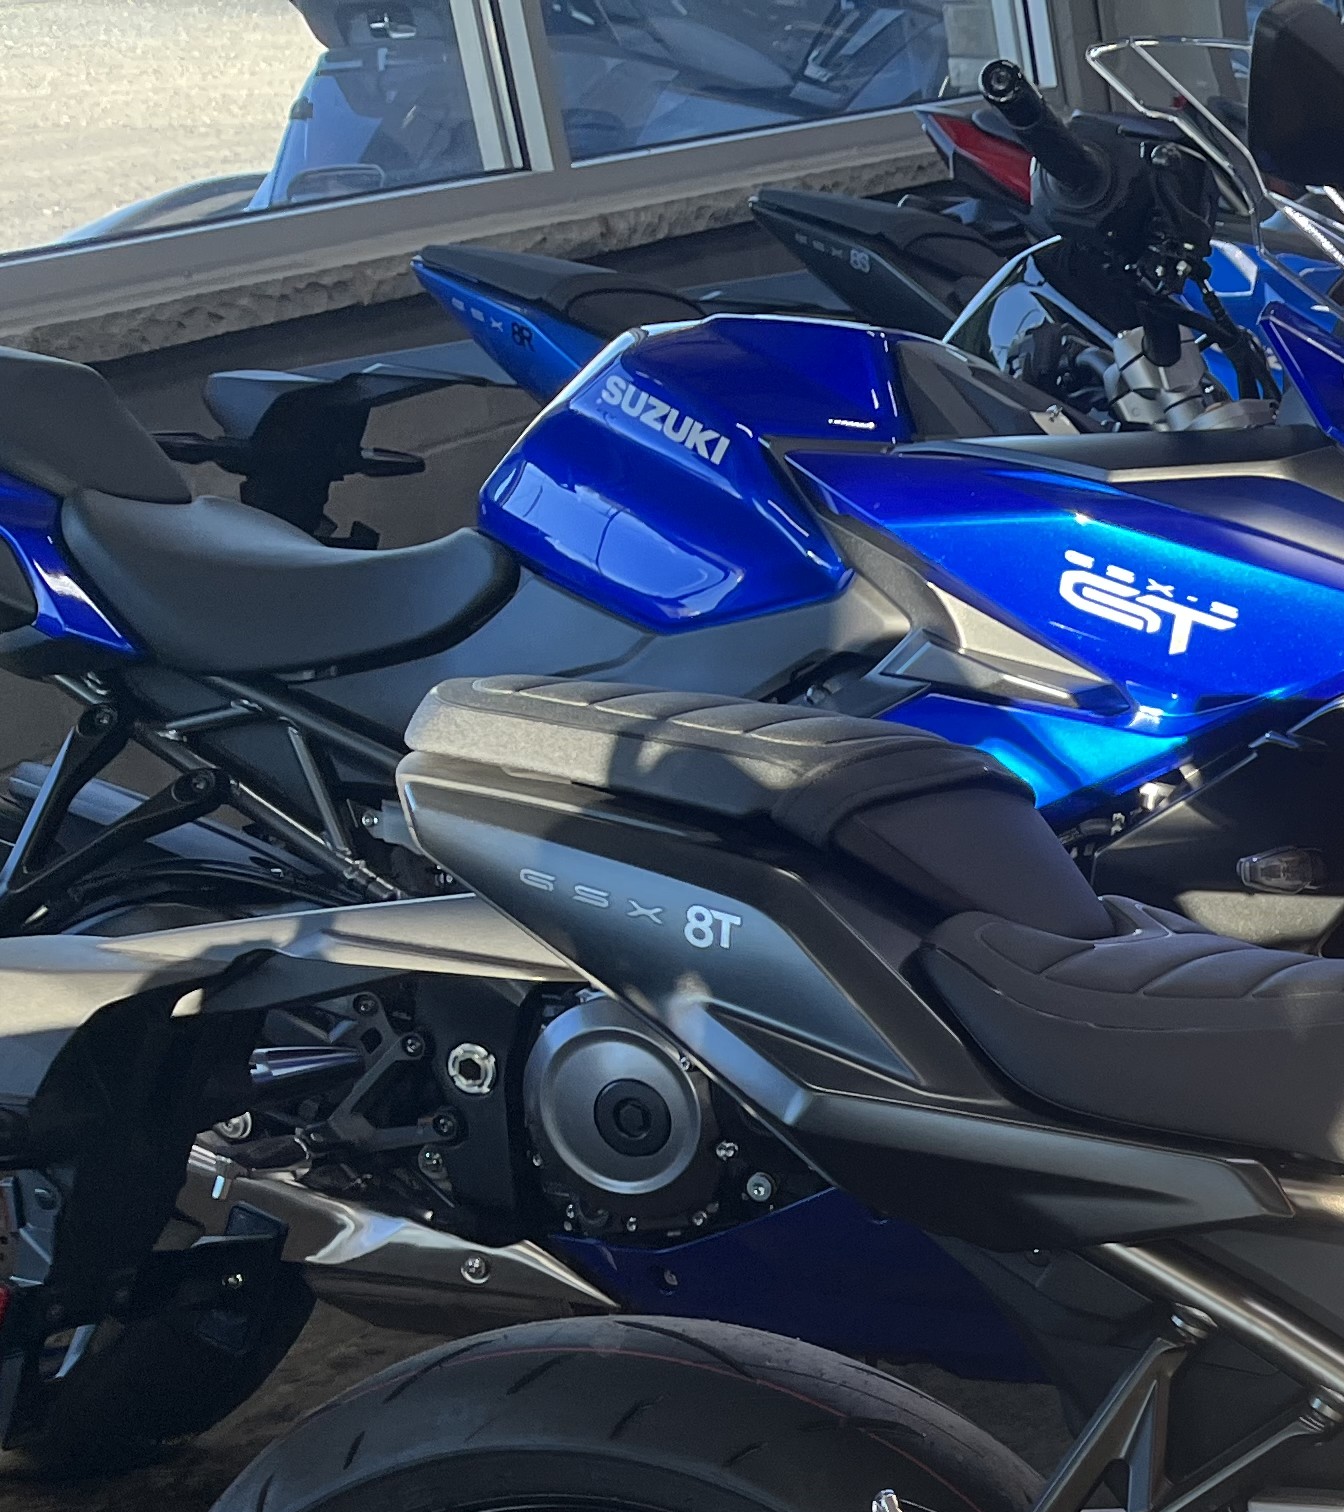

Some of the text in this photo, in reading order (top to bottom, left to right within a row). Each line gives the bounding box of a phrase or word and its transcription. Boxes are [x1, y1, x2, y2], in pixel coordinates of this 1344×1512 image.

[511, 321, 536, 353] 8R
[601, 375, 731, 465] SUZUKI
[684, 904, 742, 950] 8T
